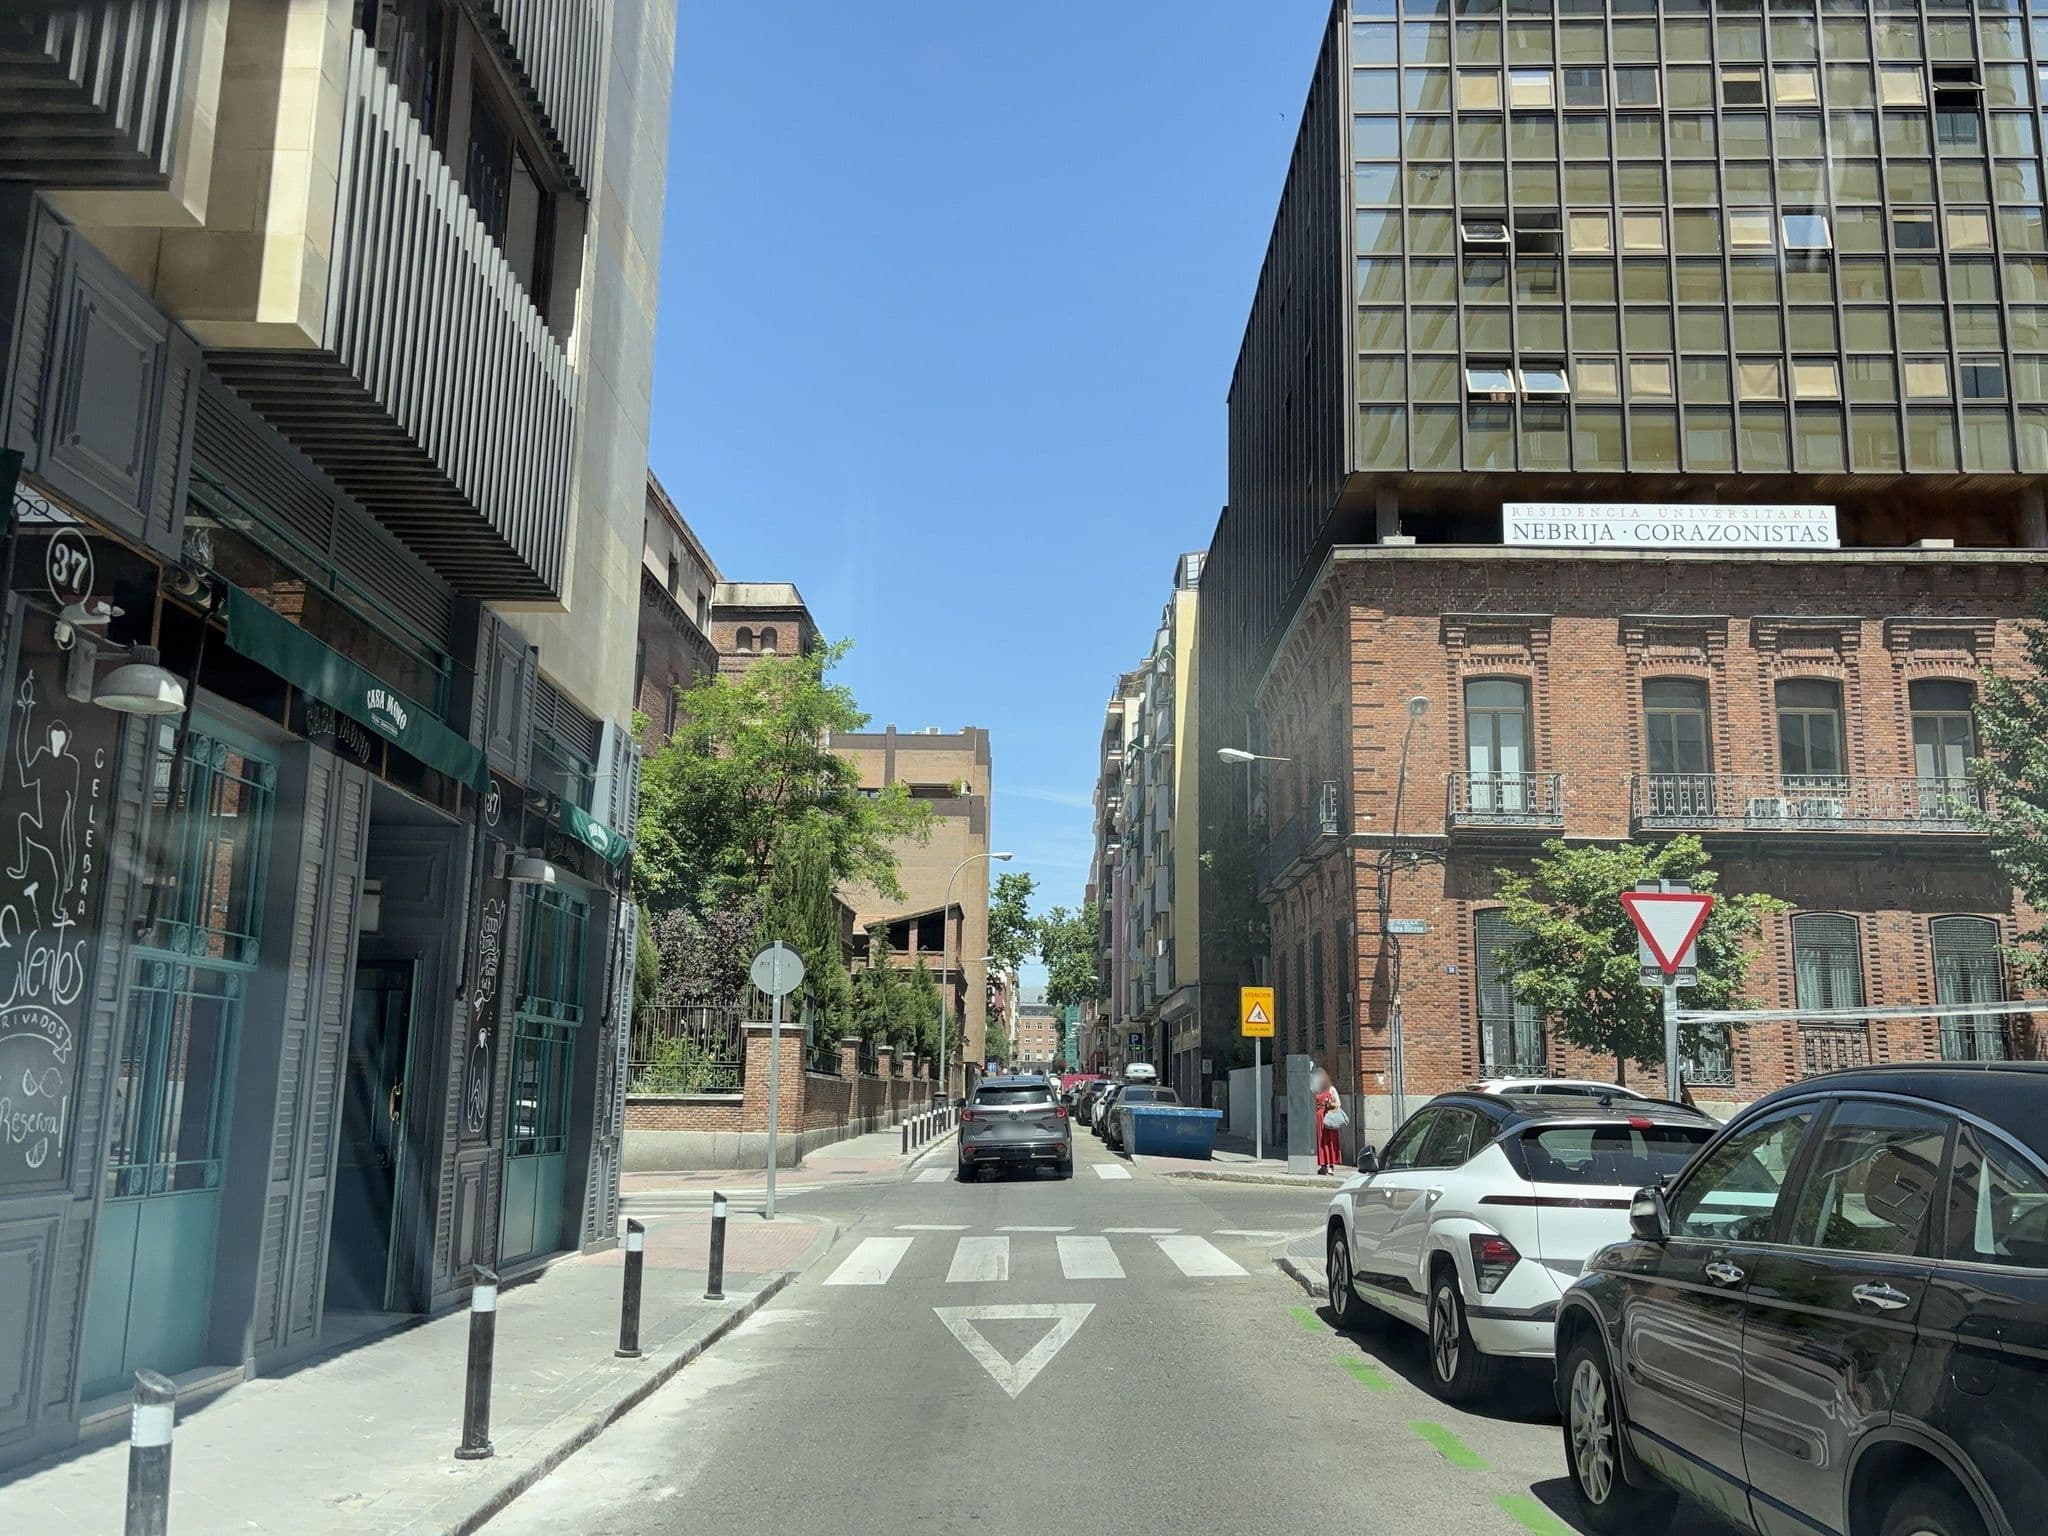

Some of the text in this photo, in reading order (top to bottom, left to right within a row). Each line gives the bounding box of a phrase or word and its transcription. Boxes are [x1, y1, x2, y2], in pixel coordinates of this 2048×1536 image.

[1511, 506, 1829, 520] RESIDENCIA UNIVERSITARIA
[1512, 522, 1829, 545] NEBRIJA CORAZONISTAS
[53, 543, 88, 591] 37
[366, 688, 386, 710] CASA
[386, 694, 408, 730] MONO
[486, 792, 499, 815] 37
[77, 748, 105, 916] CELEBRA
[1, 1012, 65, 1039] RIVADOS
